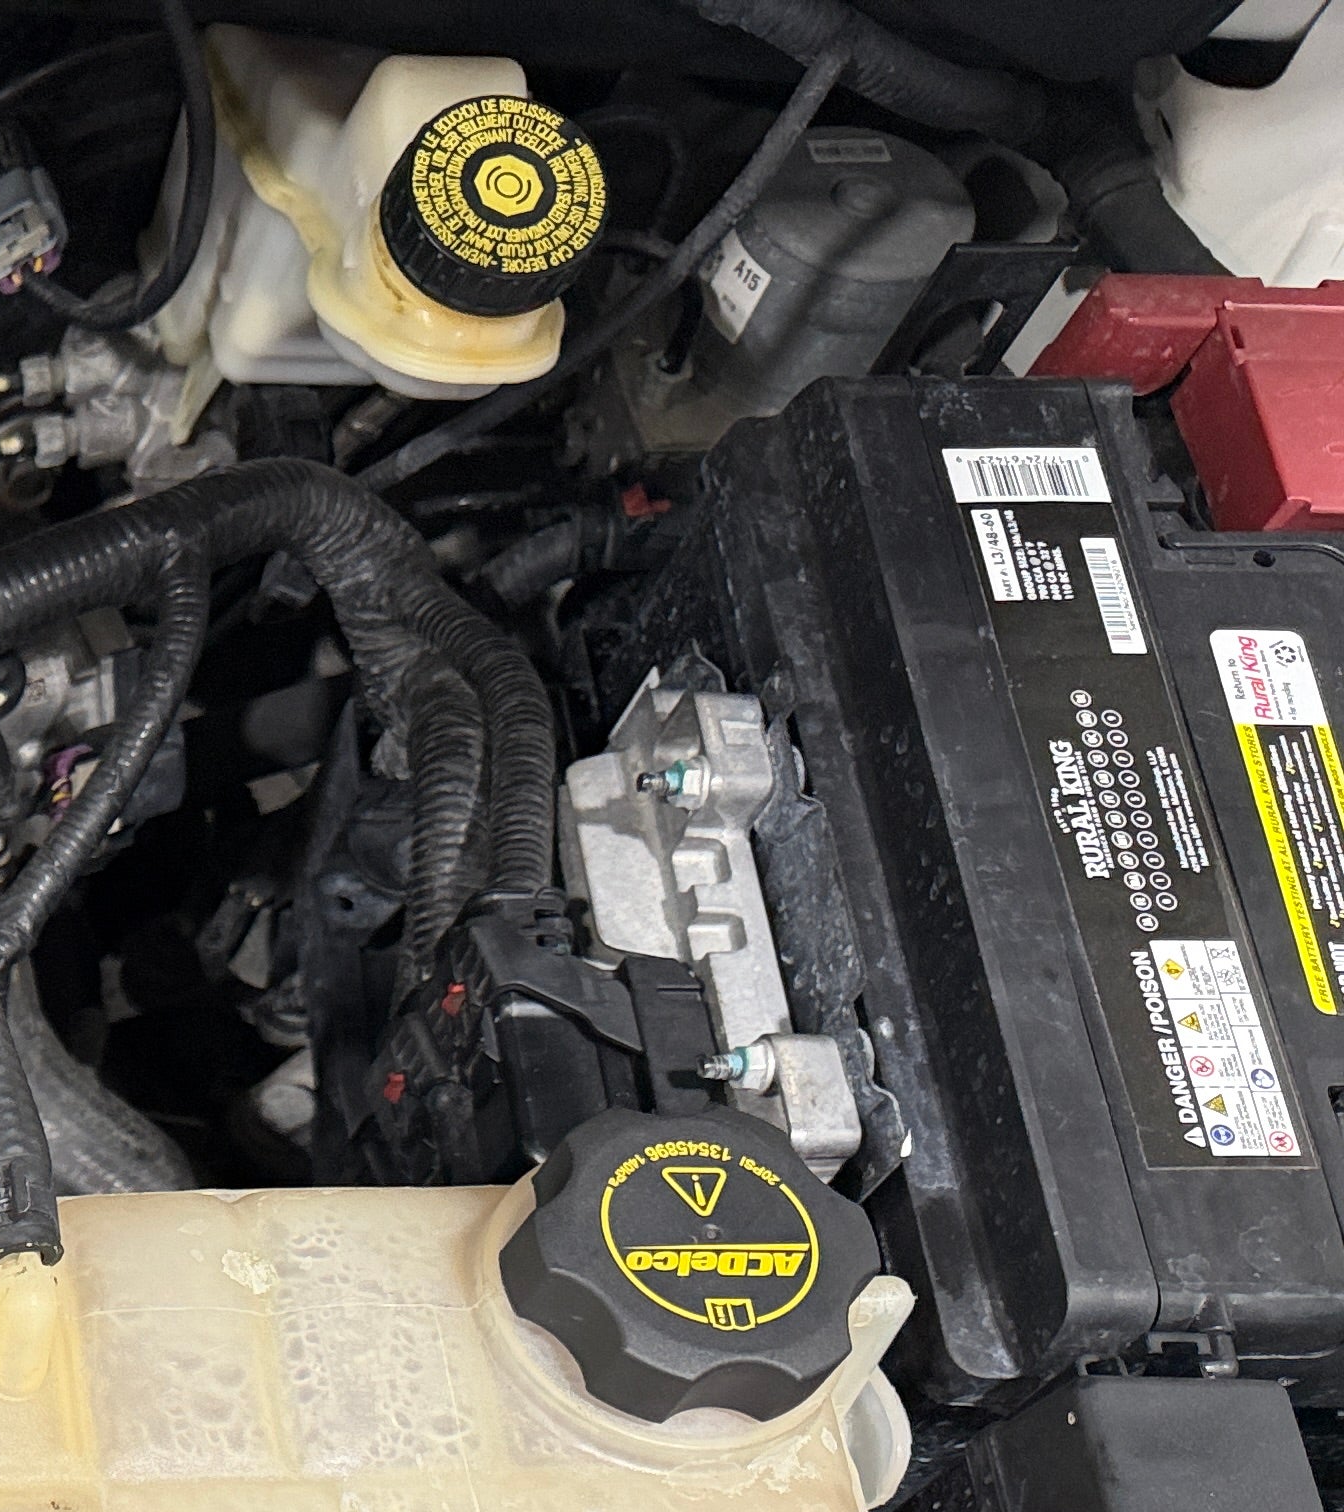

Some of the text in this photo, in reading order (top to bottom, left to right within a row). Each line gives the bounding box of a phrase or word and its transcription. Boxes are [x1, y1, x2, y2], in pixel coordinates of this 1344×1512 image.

[421, 131, 440, 148] LE
[434, 102, 479, 134] BOUCHON
[480, 98, 498, 113] DE
[457, 128, 513, 157] CONTENANT
[444, 214, 462, 231] DE
[512, 115, 529, 130] DU
[556, 183, 571, 191] A
[547, 191, 571, 223] SEALED
[564, 205, 585, 227] USE
[533, 237, 553, 253] DOT
[550, 223, 573, 246] ONLY
[496, 242, 526, 257] FLUID
[501, 256, 547, 272] BEFORE
[549, 245, 573, 265] CAP
[733, 259, 761, 292] A15
[978, 455, 1018, 465] 61423
[980, 513, 1004, 564] L3/48-60
[1002, 579, 1013, 597] PART
[1021, 570, 1036, 599] GROUP
[1046, 571, 1056, 583] CA
[1062, 584, 1073, 599] 110
[1228, 658, 1245, 699] Return to
[1238, 636, 1272, 718] Rural King
[1050, 740, 1108, 877] RURAL KING
[1243, 726, 1330, 1004] FREE BATTERY TESTING AT ALL RURAL KING STORES
[1158, 1038, 1196, 1122] DANGER
[605, 1140, 781, 1187] 20PSI 13545896 140kPa
[624, 1249, 806, 1277] ACDelco
